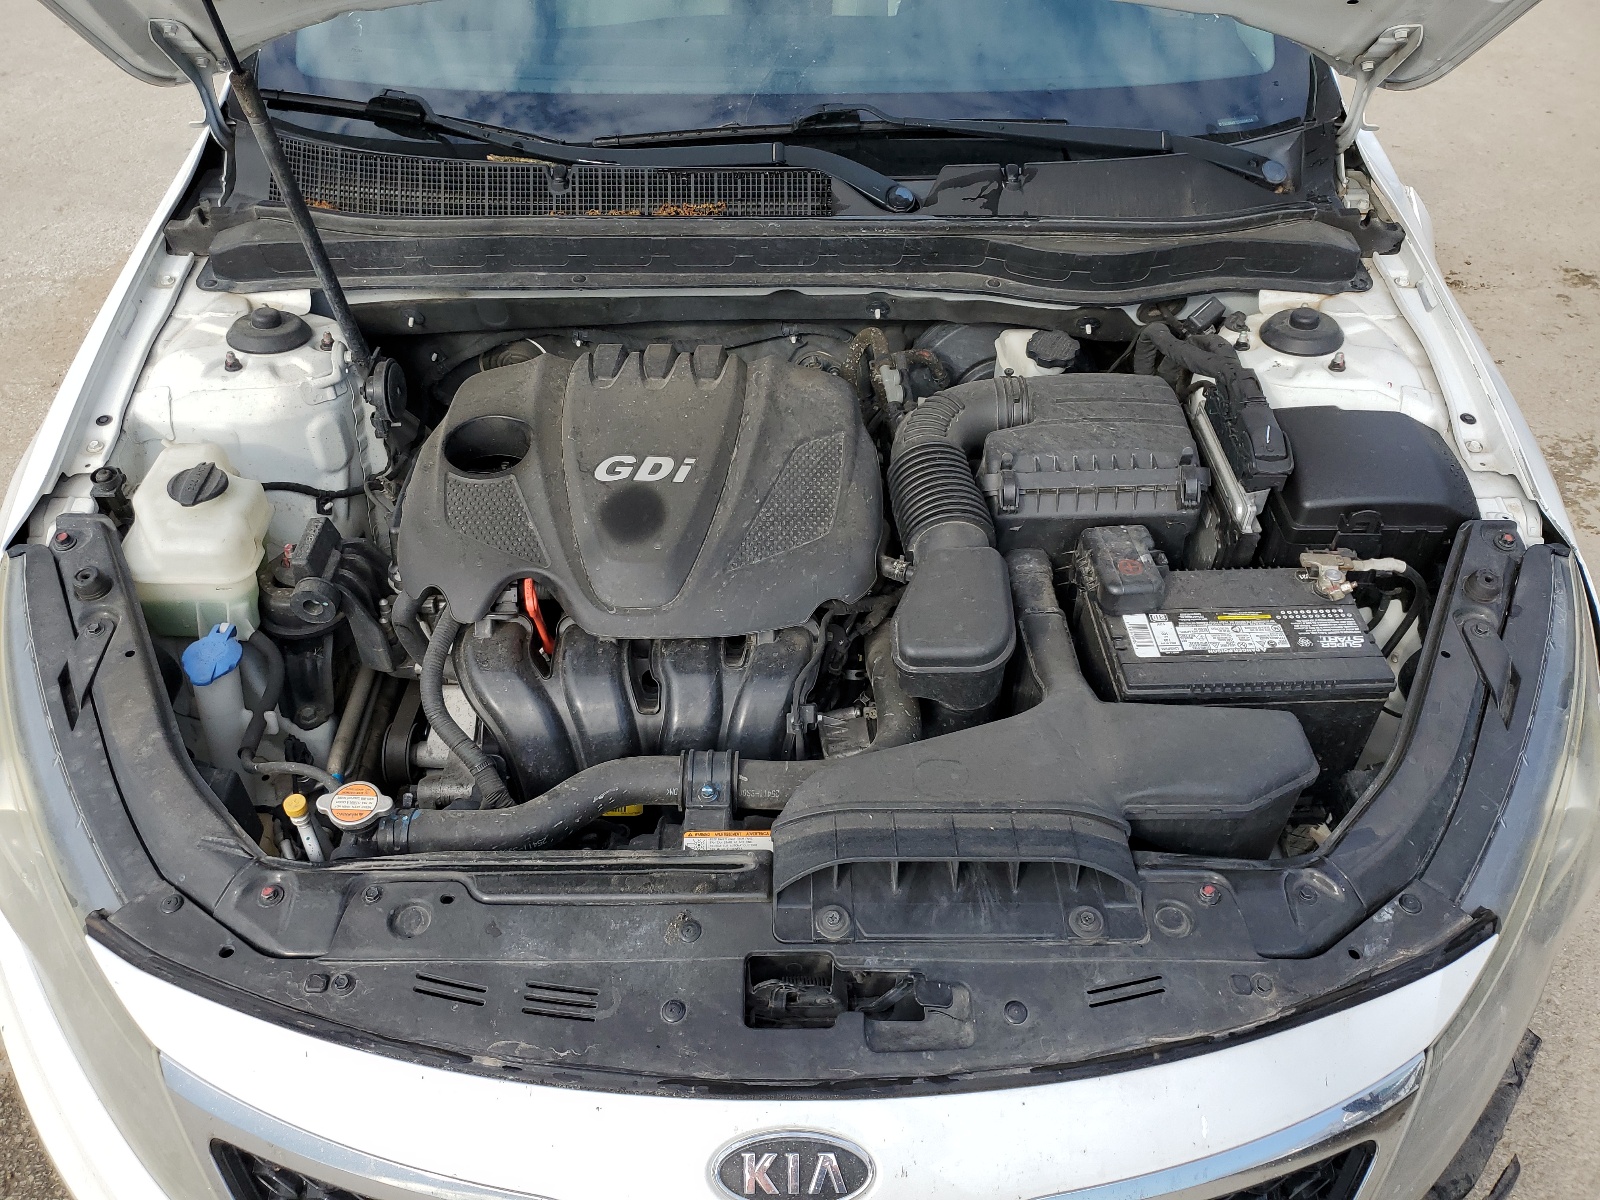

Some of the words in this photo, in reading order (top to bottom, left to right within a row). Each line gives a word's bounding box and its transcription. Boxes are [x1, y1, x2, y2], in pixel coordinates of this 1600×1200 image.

[594, 455, 698, 483] GDi
[1319, 635, 1365, 643] START
[740, 1152, 848, 1195] KIA
